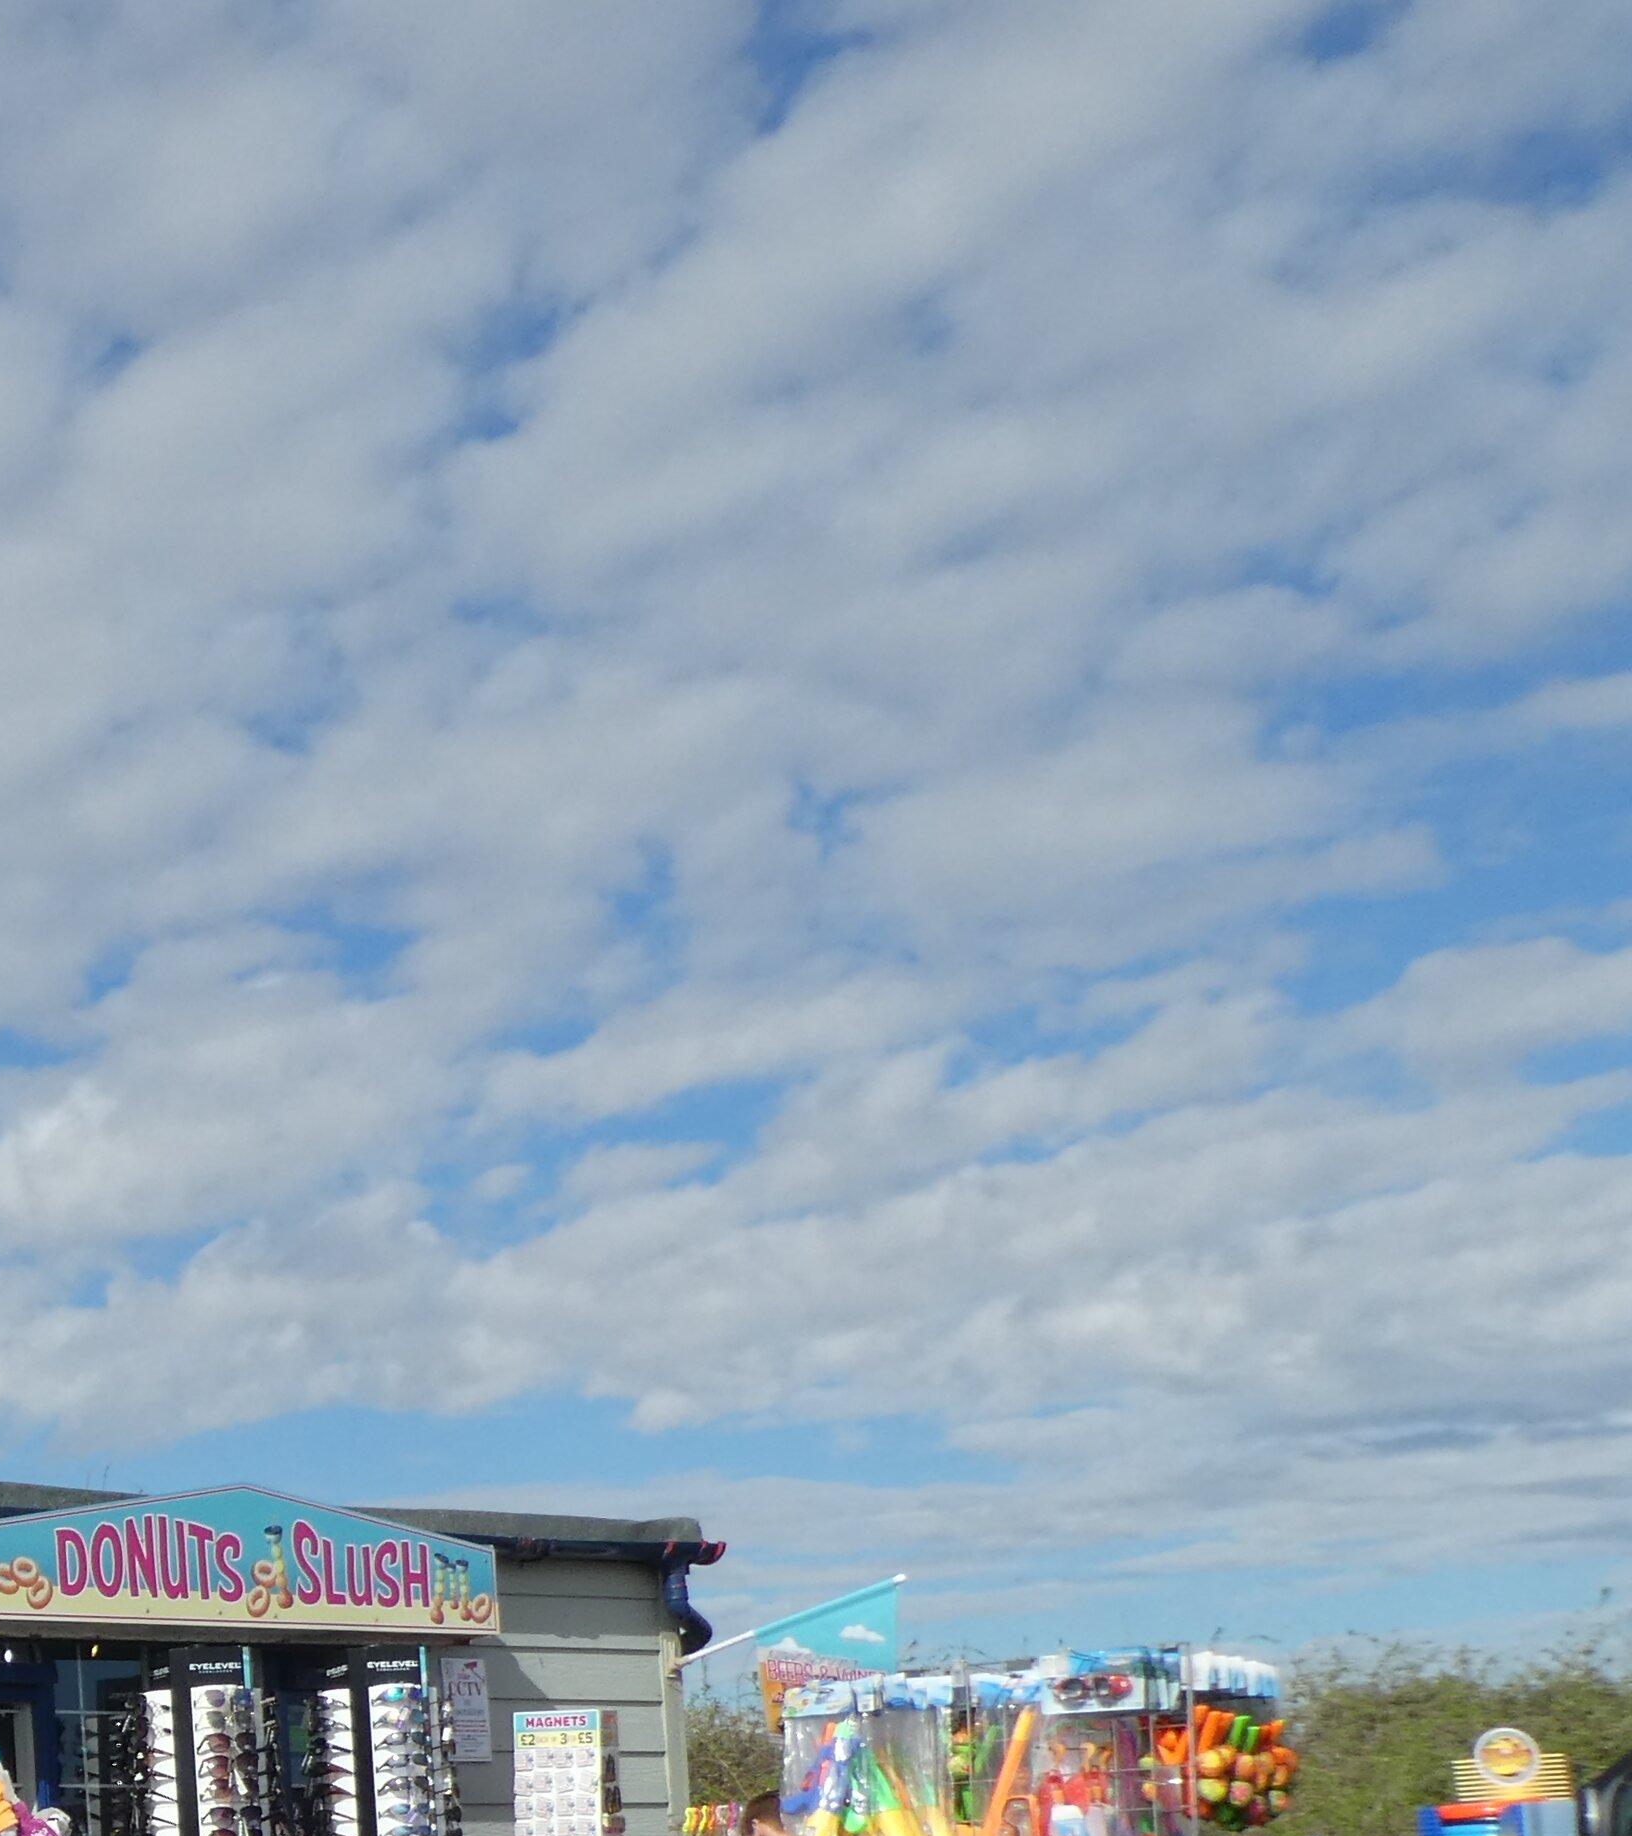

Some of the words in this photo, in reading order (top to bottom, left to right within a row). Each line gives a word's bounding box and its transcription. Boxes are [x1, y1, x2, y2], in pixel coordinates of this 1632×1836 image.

[54, 1515, 244, 1603] DONUTS
[293, 1519, 430, 1608] SLUSH
[189, 1662, 241, 1671] EYELEVEL
[367, 1660, 418, 1669] EYELEVEL
[836, 1667, 882, 1681] WINE
[526, 1715, 586, 1728] MAGNETS
[521, 1733, 535, 1746] £2
[560, 1733, 568, 1744] 3
[578, 1732, 593, 1744] £5
